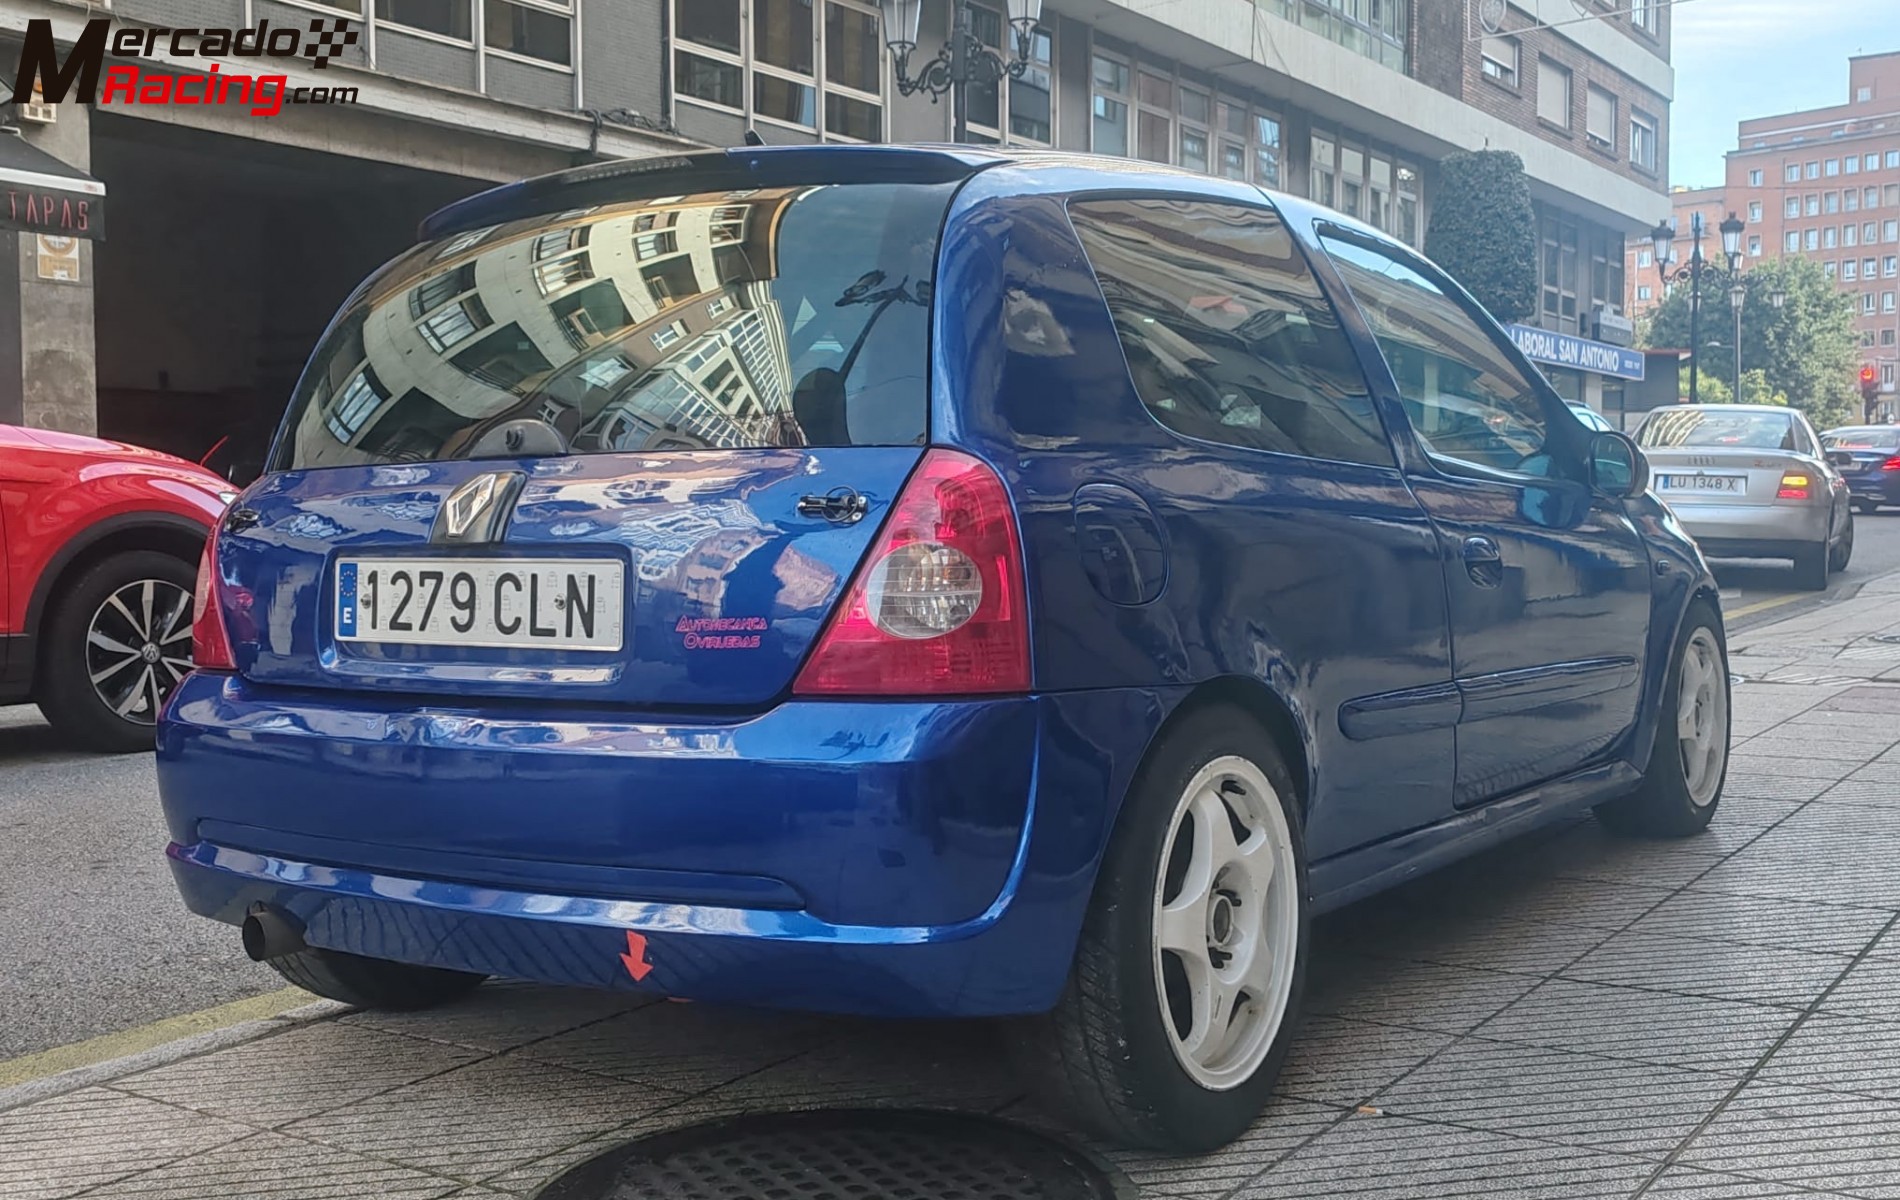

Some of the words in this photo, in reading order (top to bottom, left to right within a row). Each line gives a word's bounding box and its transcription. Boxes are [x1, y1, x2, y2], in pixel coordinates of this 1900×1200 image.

[7, 191, 89, 231] TAPAS
[1558, 339, 1578, 364] SAN
[1580, 344, 1619, 372] ANTONIO
[1670, 475, 1686, 488] LU
[1692, 475, 1723, 489] 1348
[1727, 477, 1736, 490] X
[343, 607, 353, 624] E
[367, 570, 477, 634] 1279
[494, 572, 596, 639] CLN
